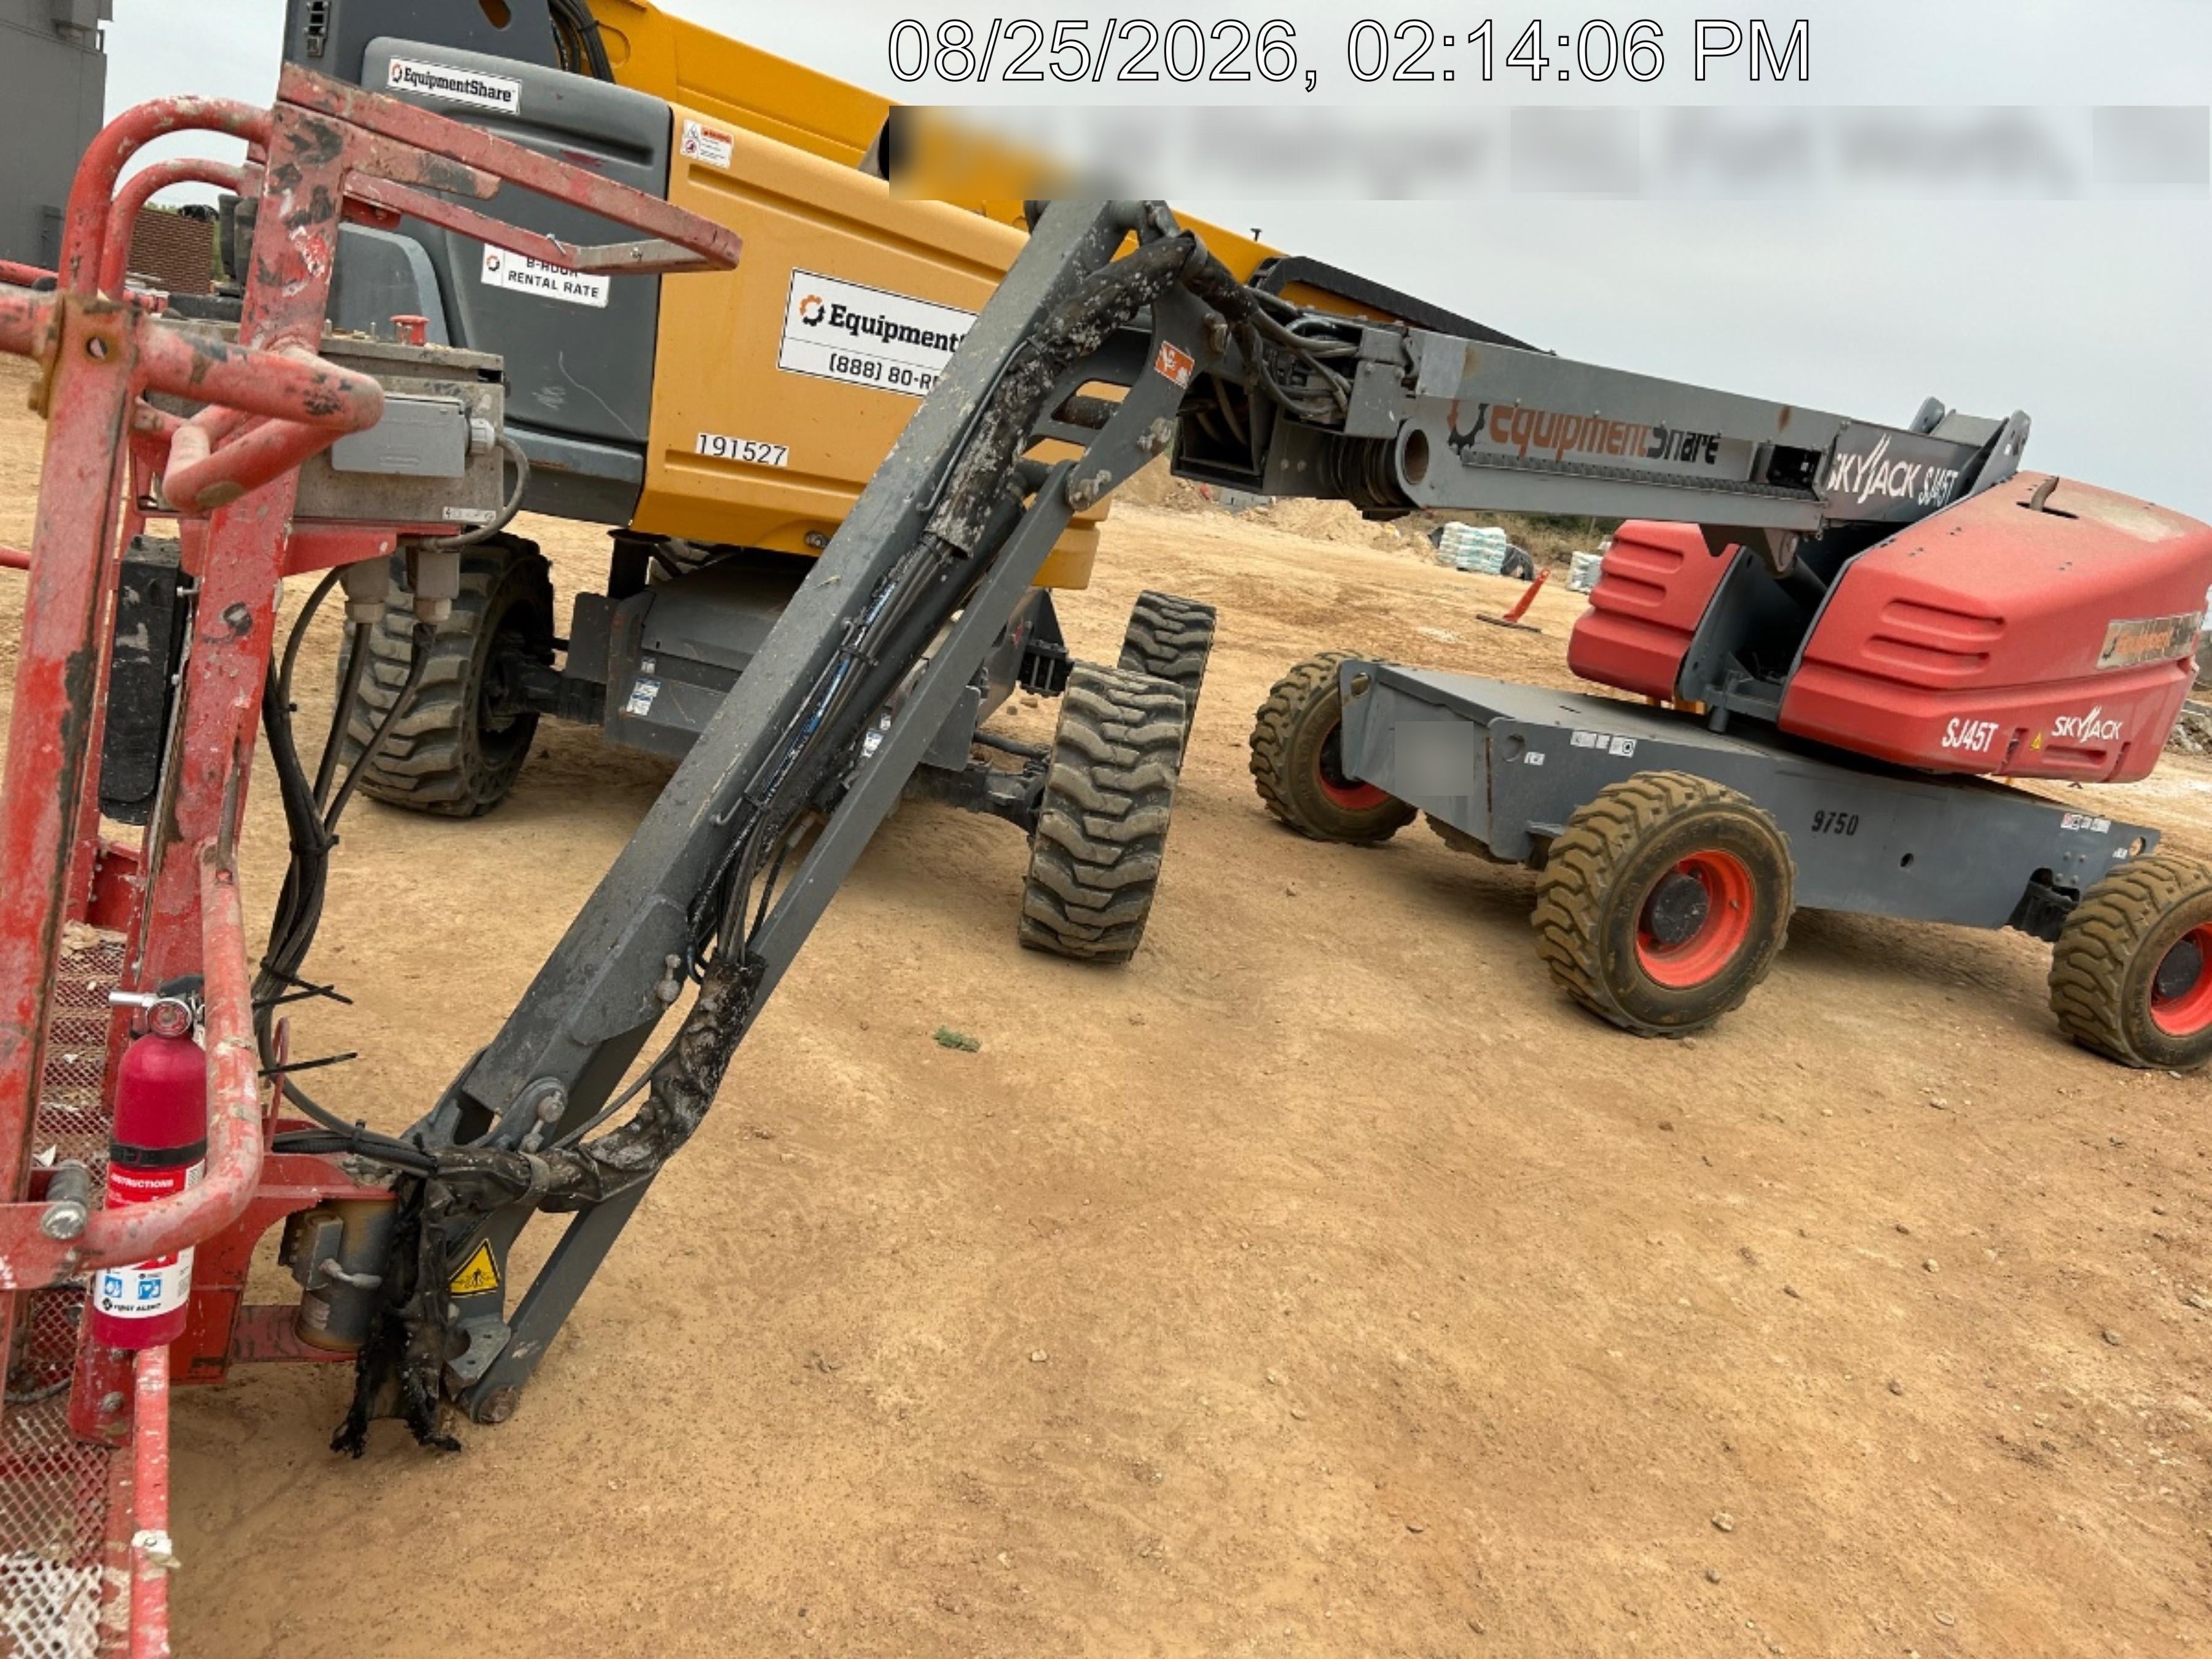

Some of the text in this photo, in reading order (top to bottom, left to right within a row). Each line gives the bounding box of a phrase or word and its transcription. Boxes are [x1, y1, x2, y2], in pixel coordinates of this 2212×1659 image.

[403, 66, 512, 102] EquipmentShare
[508, 270, 600, 298] RENTAL RATE
[828, 304, 966, 353] Equipment
[830, 353, 882, 380] (888)
[700, 434, 787, 465] 191527
[1918, 465, 1959, 508] SJ45T
[1942, 705, 2123, 753] SJ45T SKYJACK
[1811, 810, 1859, 836] 9750
